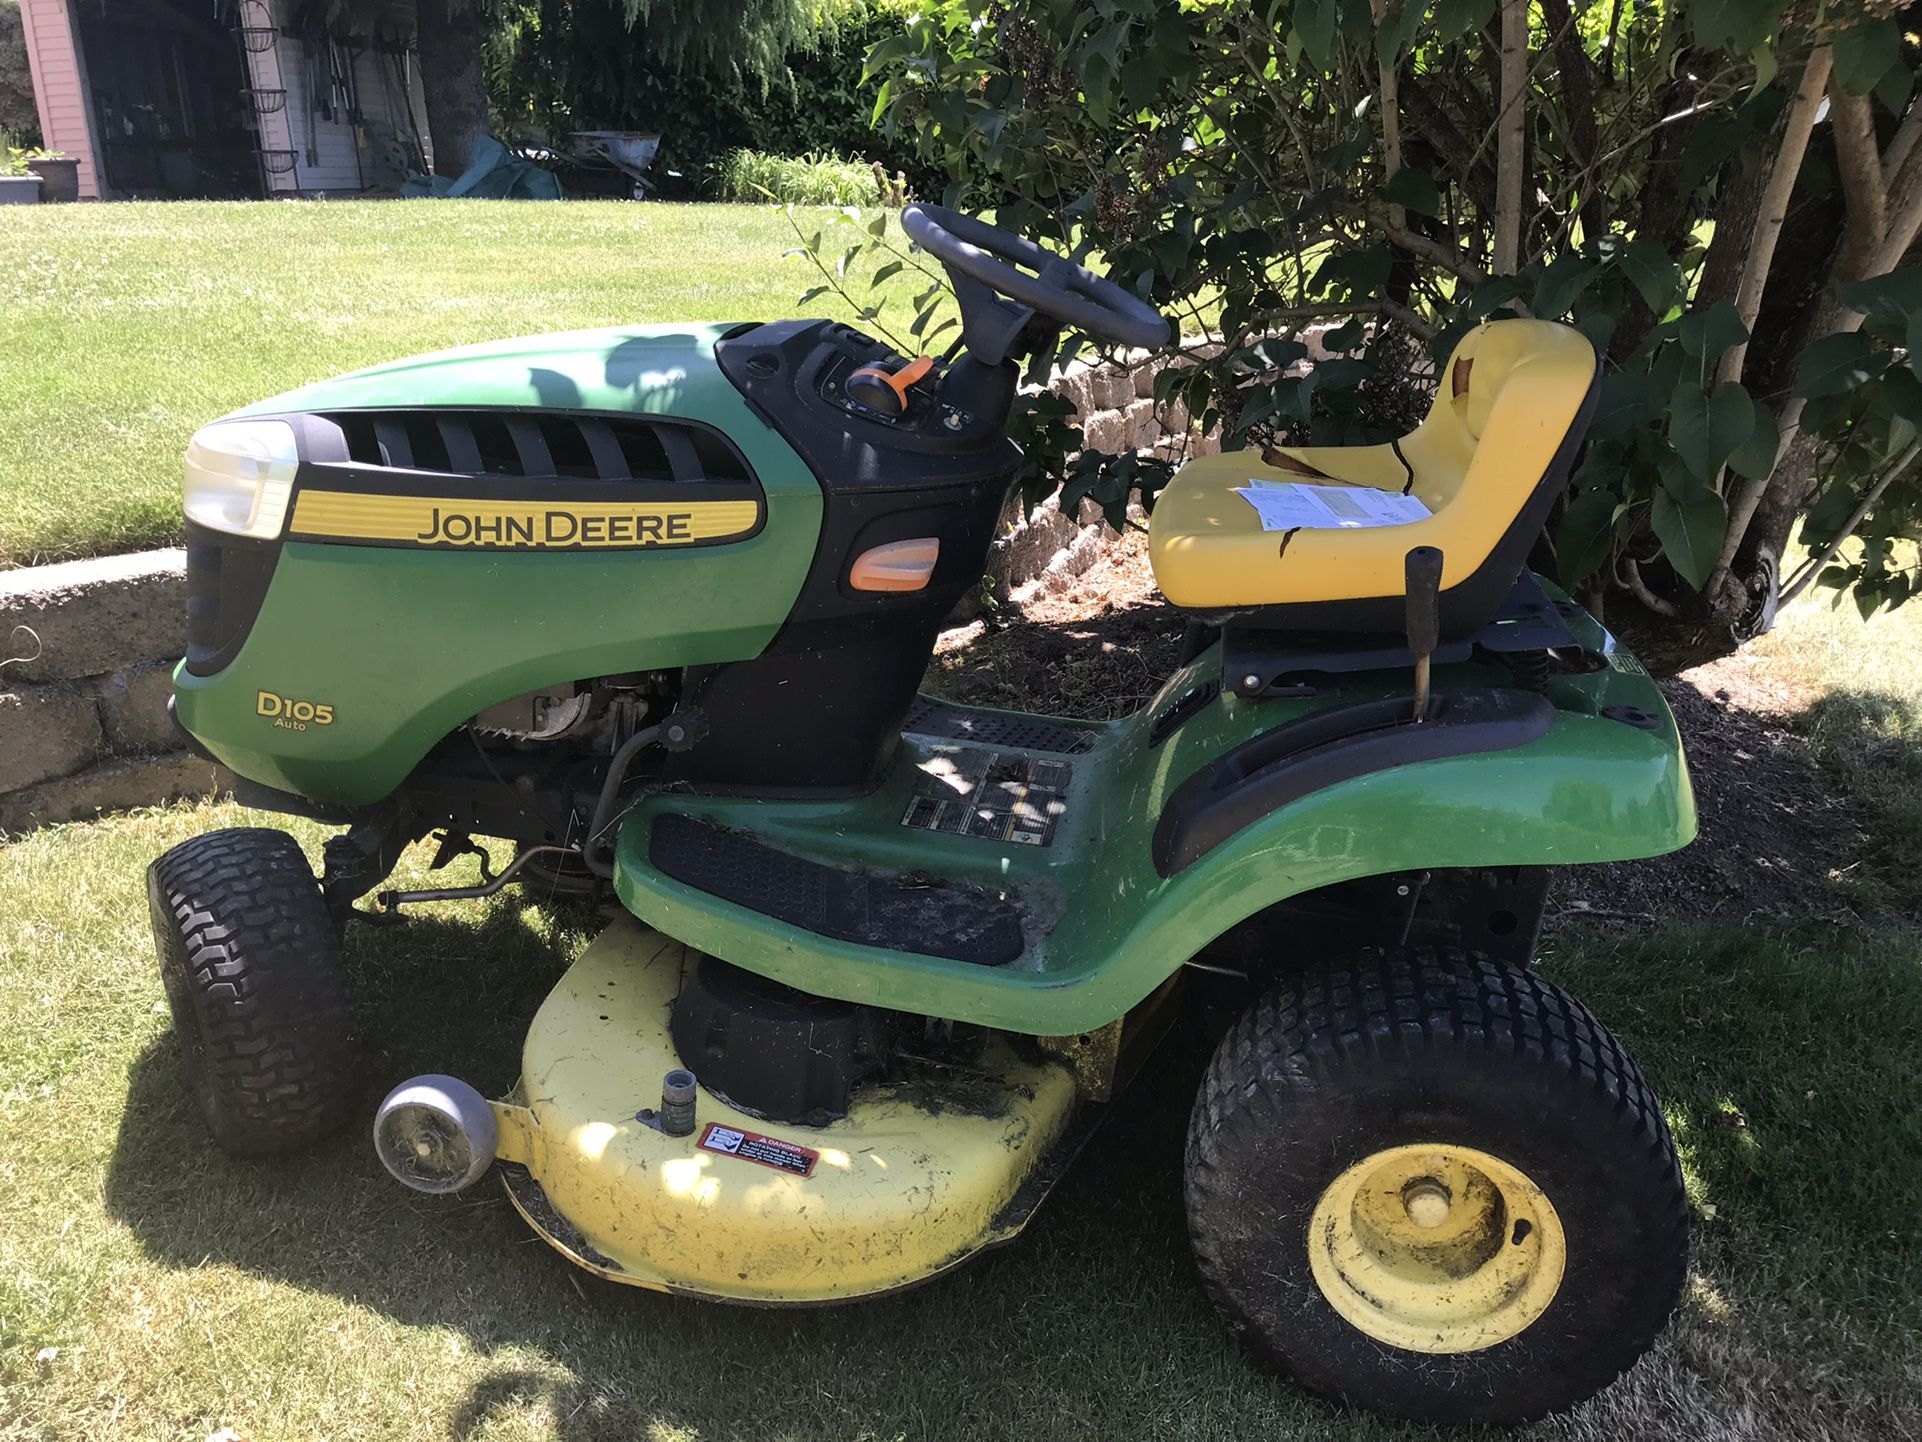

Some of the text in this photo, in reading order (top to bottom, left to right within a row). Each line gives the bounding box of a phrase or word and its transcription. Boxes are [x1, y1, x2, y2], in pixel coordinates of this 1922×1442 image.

[417, 508, 692, 542] JOHN DEERE
[256, 690, 334, 725] D105
[274, 718, 306, 731] Auto
[748, 1141, 780, 1153] ROTATING
[767, 1139, 802, 1153] DANGER
